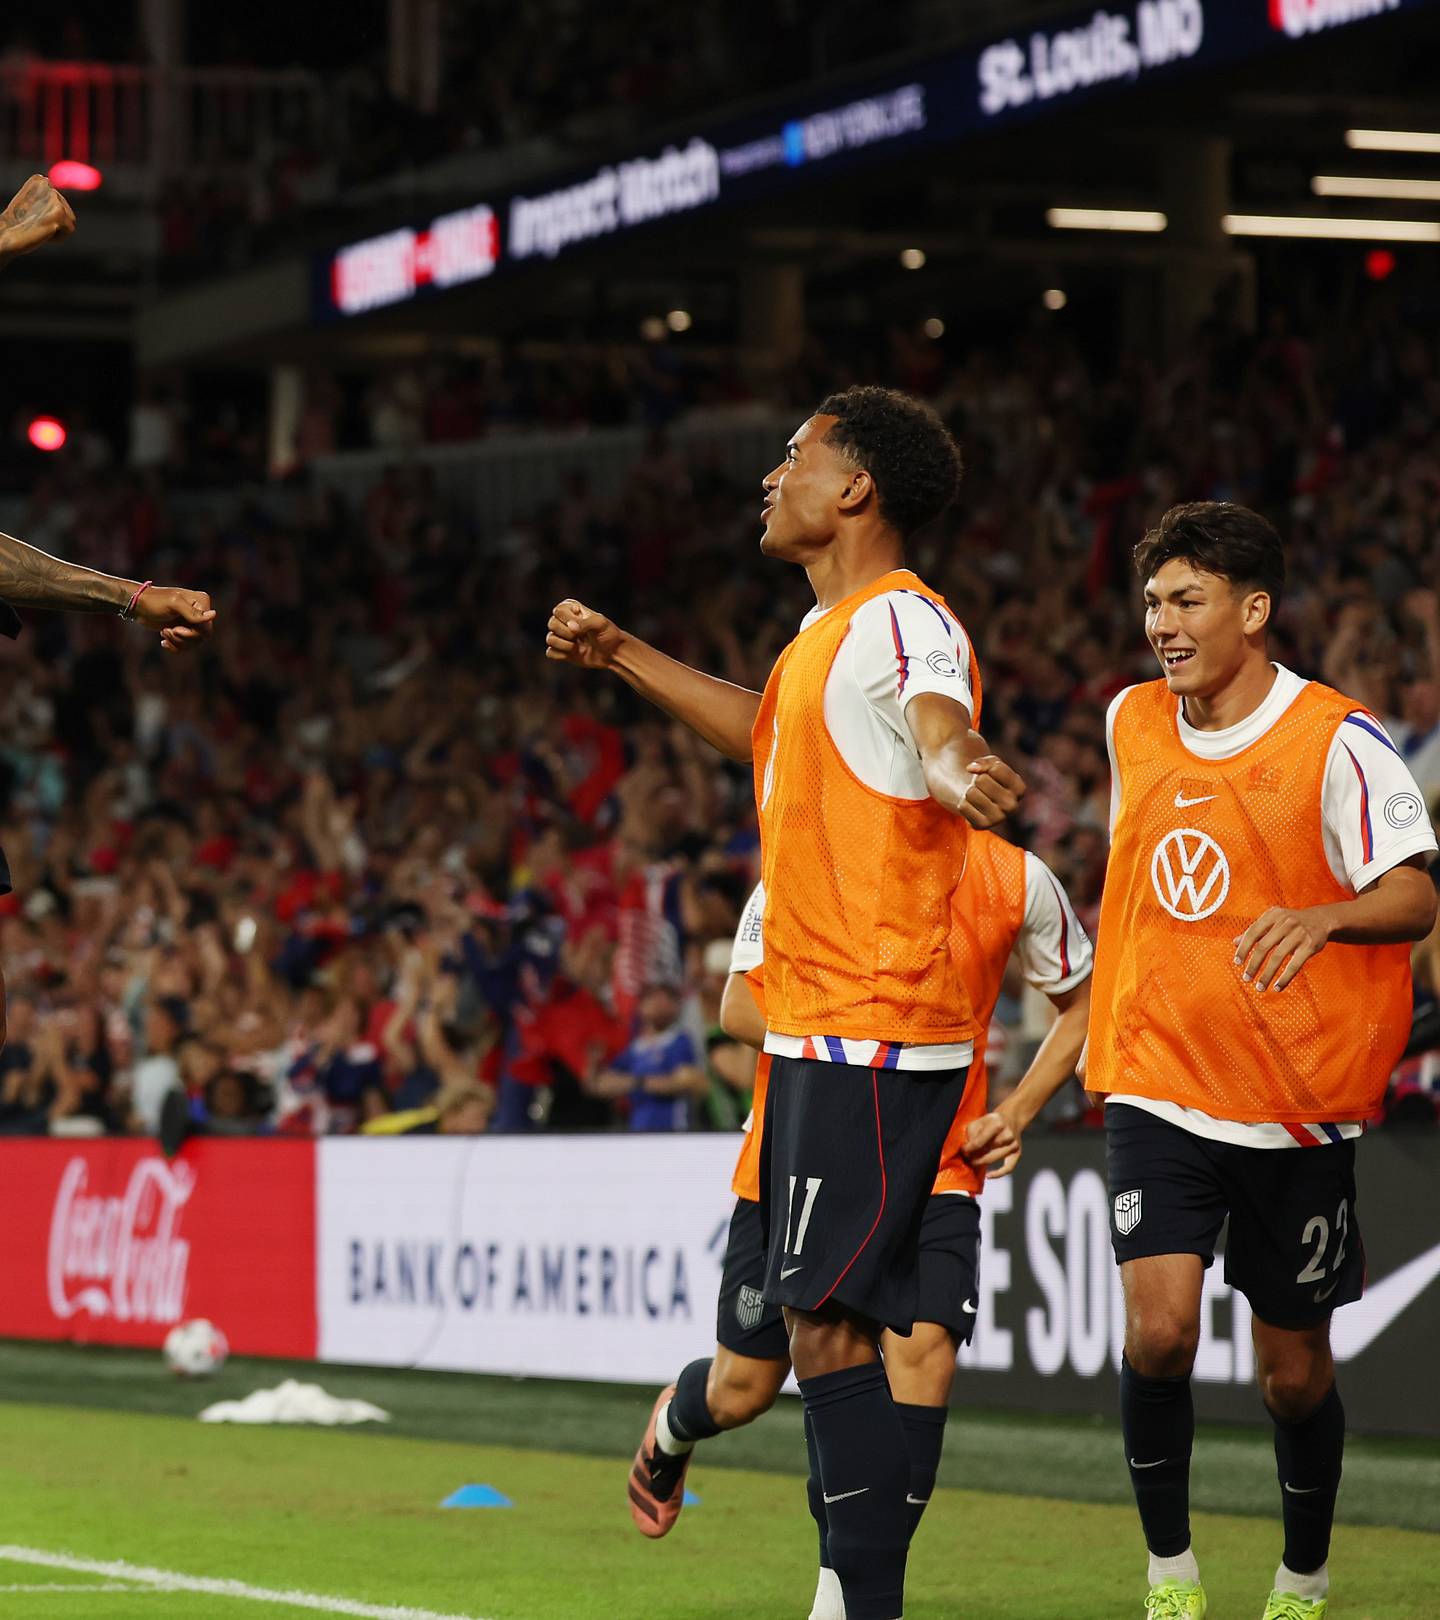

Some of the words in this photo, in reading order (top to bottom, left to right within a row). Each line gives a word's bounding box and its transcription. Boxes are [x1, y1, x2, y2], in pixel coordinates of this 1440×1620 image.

[1030, 10, 1140, 100] Louis,
[1136, 0, 1203, 66] MO
[509, 165, 618, 260] Impact
[616, 135, 720, 227] Watch
[784, 1175, 823, 1256] 11
[1116, 1191, 1139, 1211] USA
[1296, 1198, 1349, 1284] 22
[349, 1238, 446, 1307] BANK
[455, 1240, 501, 1311] OF
[510, 1243, 694, 1320] AMERICA
[740, 1287, 763, 1307] USA
